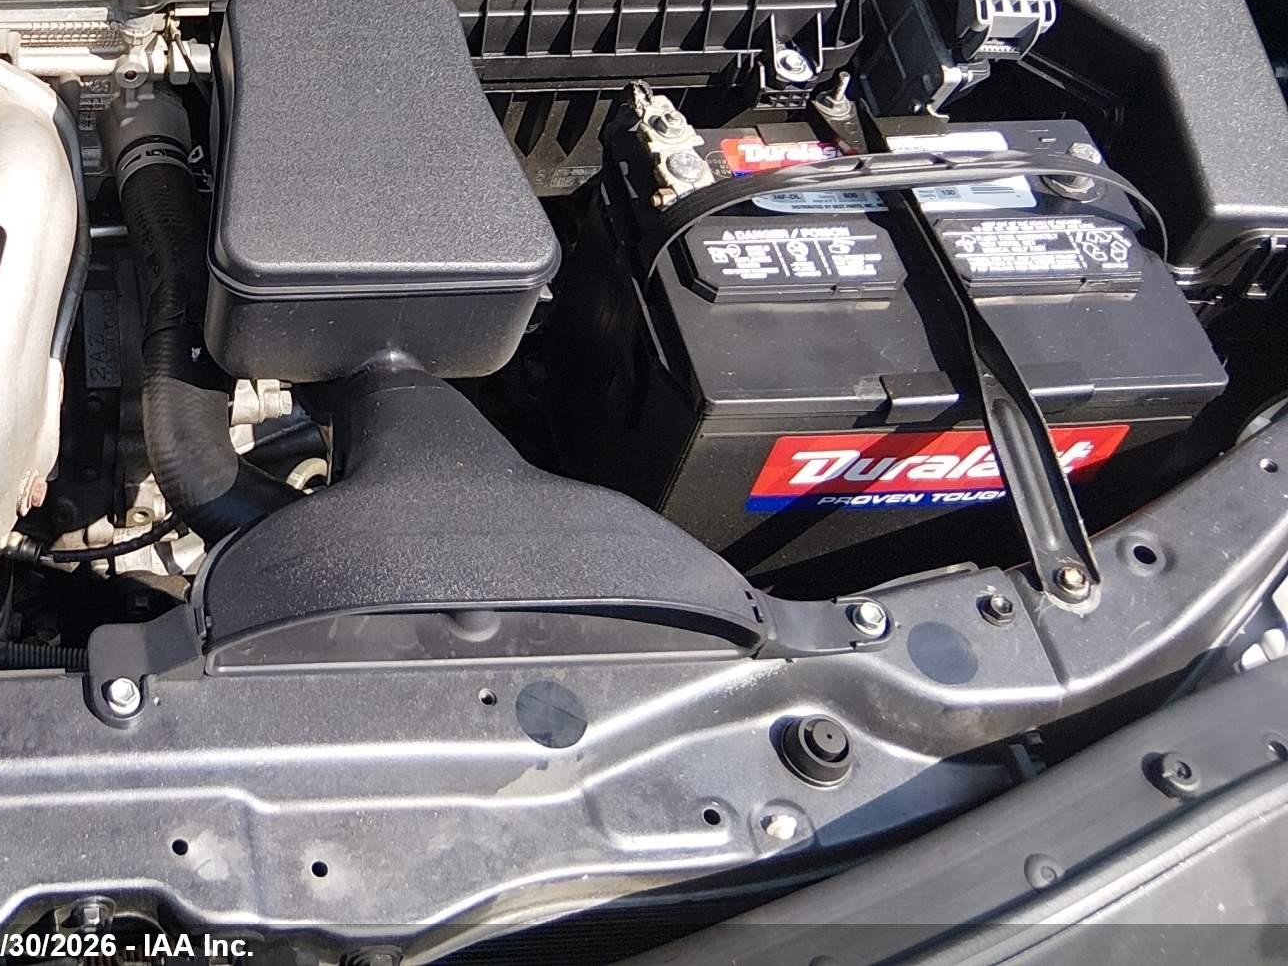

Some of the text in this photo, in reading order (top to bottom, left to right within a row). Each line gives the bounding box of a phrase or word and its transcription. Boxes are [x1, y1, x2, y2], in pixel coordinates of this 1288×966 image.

[737, 142, 839, 162] Duralas
[734, 229, 789, 241] DANGER
[800, 226, 851, 238] POISON
[788, 440, 1094, 484] Duralat
[816, 490, 1006, 506] PROVEN TOUG
